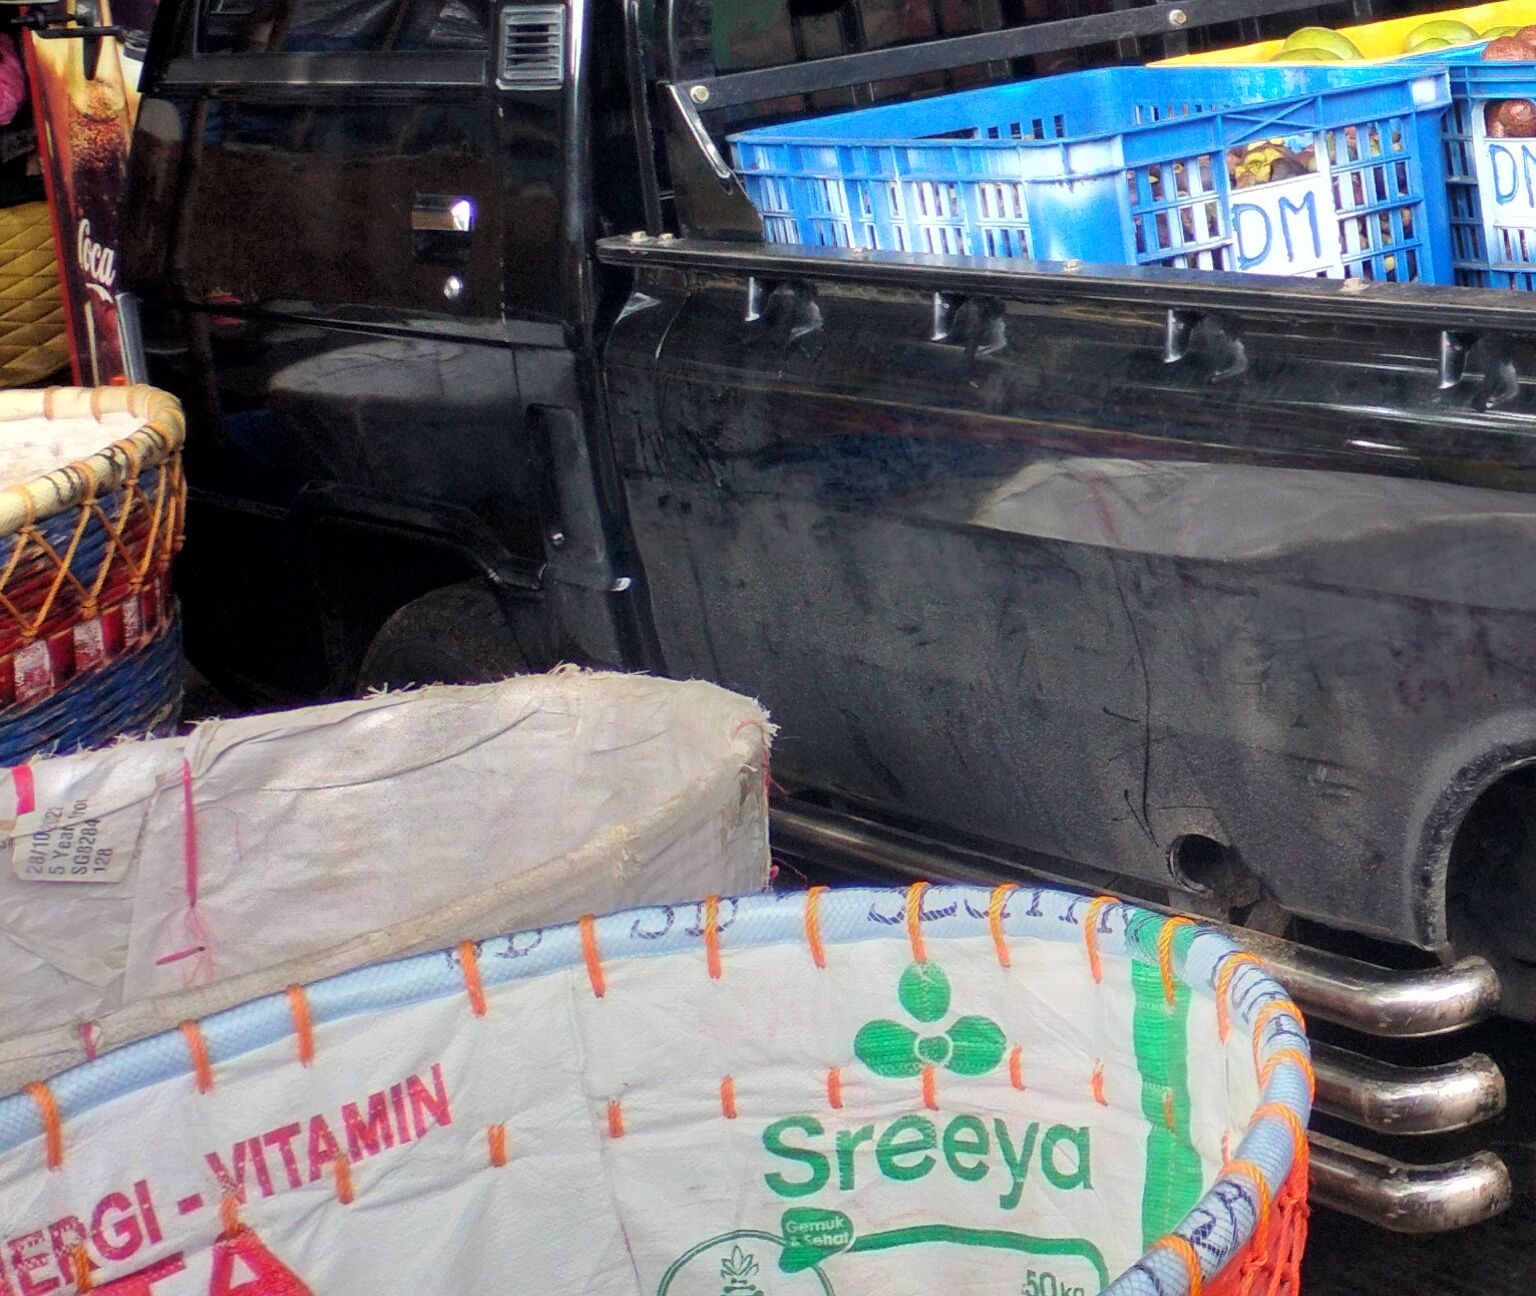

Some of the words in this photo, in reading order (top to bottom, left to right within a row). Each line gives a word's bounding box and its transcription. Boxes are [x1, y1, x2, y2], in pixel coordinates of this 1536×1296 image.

[1231, 189, 1324, 267] DM
[0, 1179, 163, 1296] ERGI
[205, 1062, 454, 1206] VITAMIN
[763, 1114, 1092, 1210] Sreeya
[786, 1215, 844, 1234] Gemuk
[804, 1231, 850, 1247] Sehat
